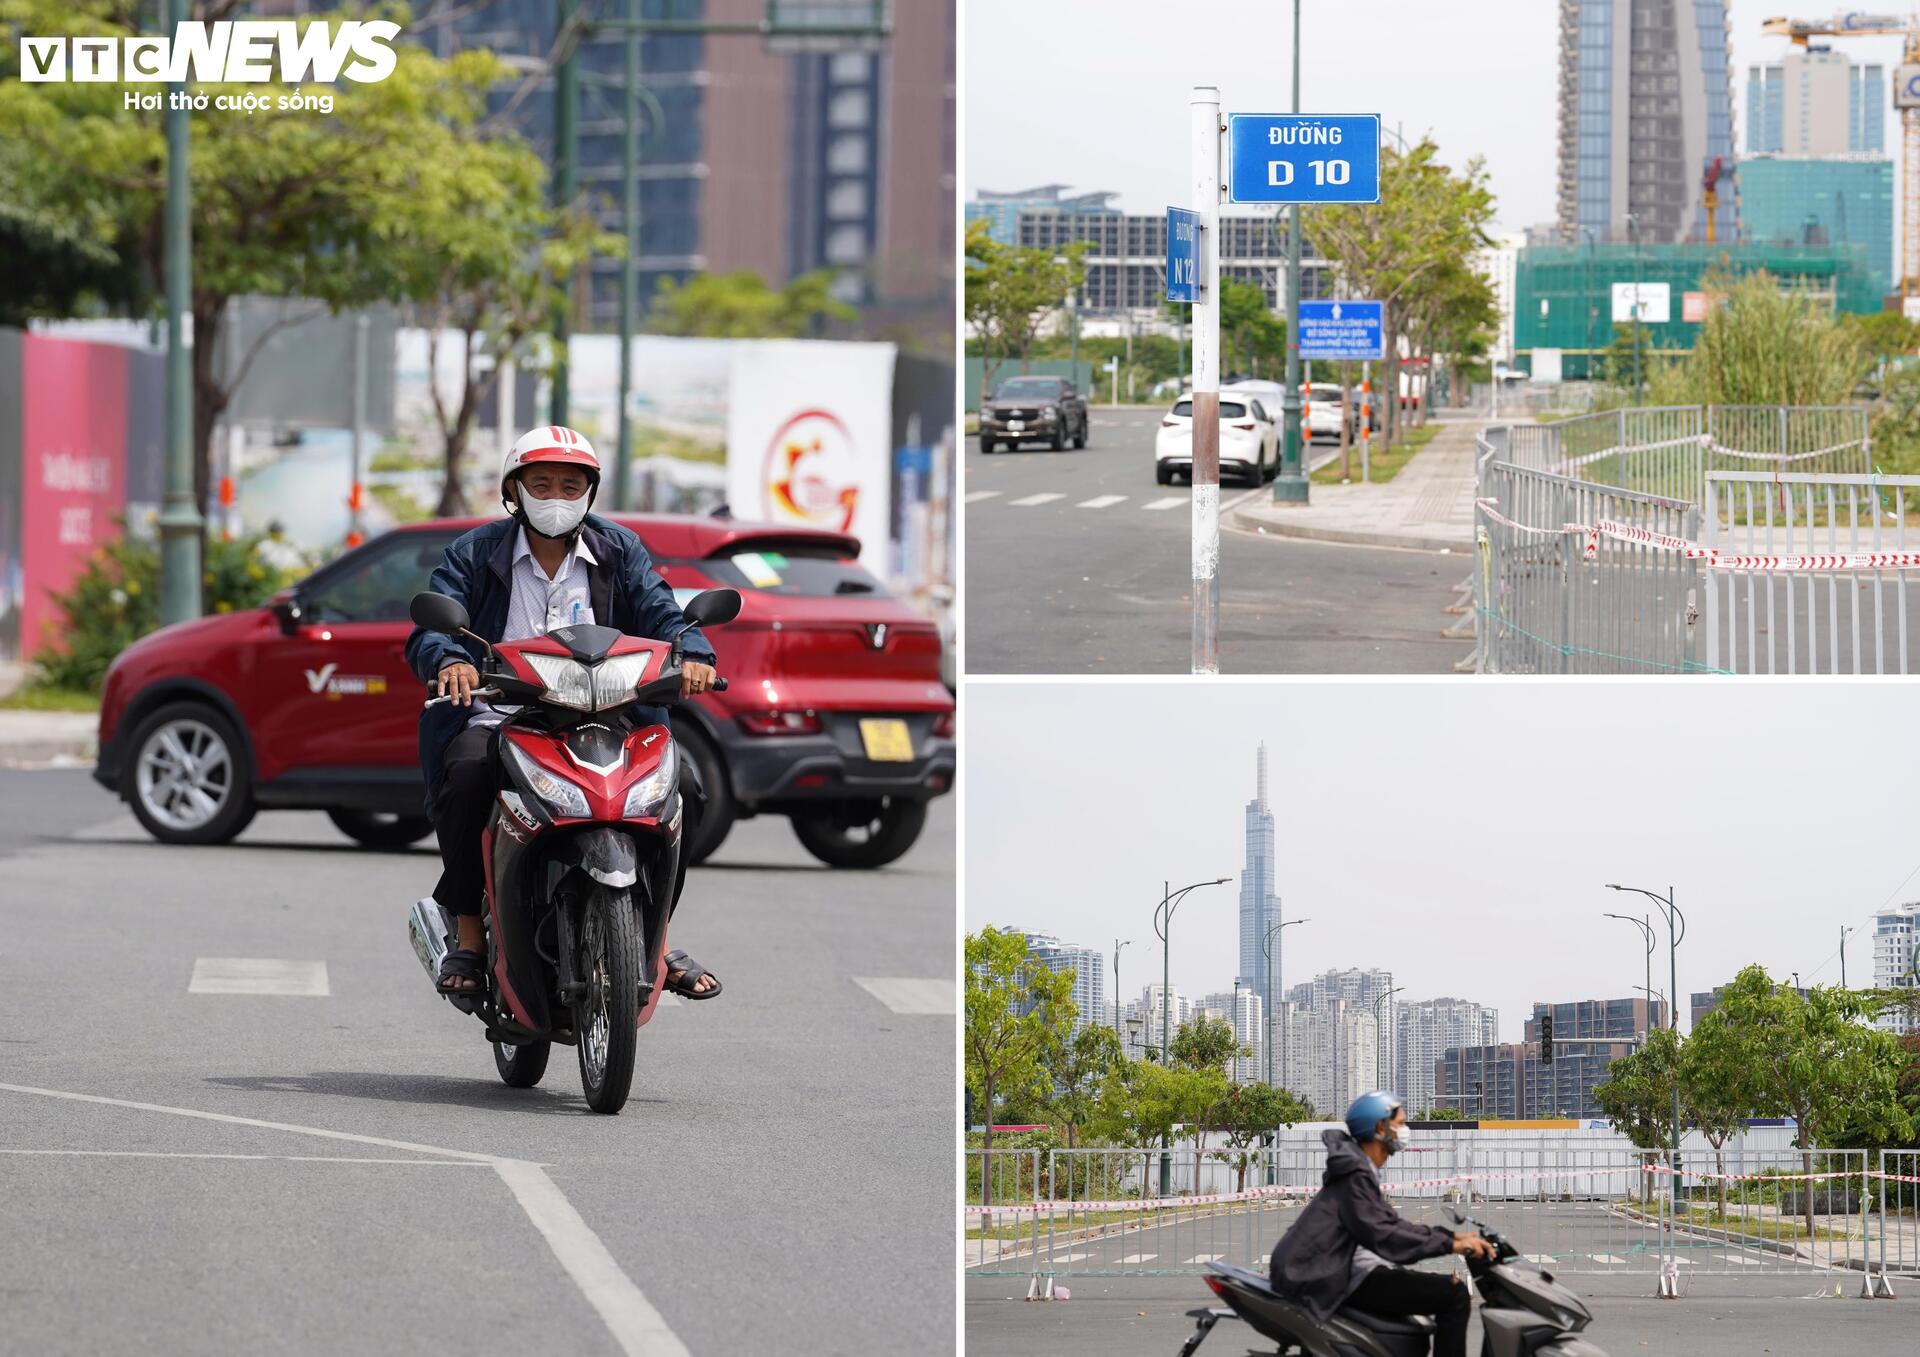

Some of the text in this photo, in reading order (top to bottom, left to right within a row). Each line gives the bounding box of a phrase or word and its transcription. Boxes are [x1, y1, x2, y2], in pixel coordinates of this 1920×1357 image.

[1268, 121, 1342, 145] ĐƯỜNG
[1268, 159, 1350, 186] D 10
[1175, 257, 1194, 285] N 12
[576, 723, 611, 731] HONDA
